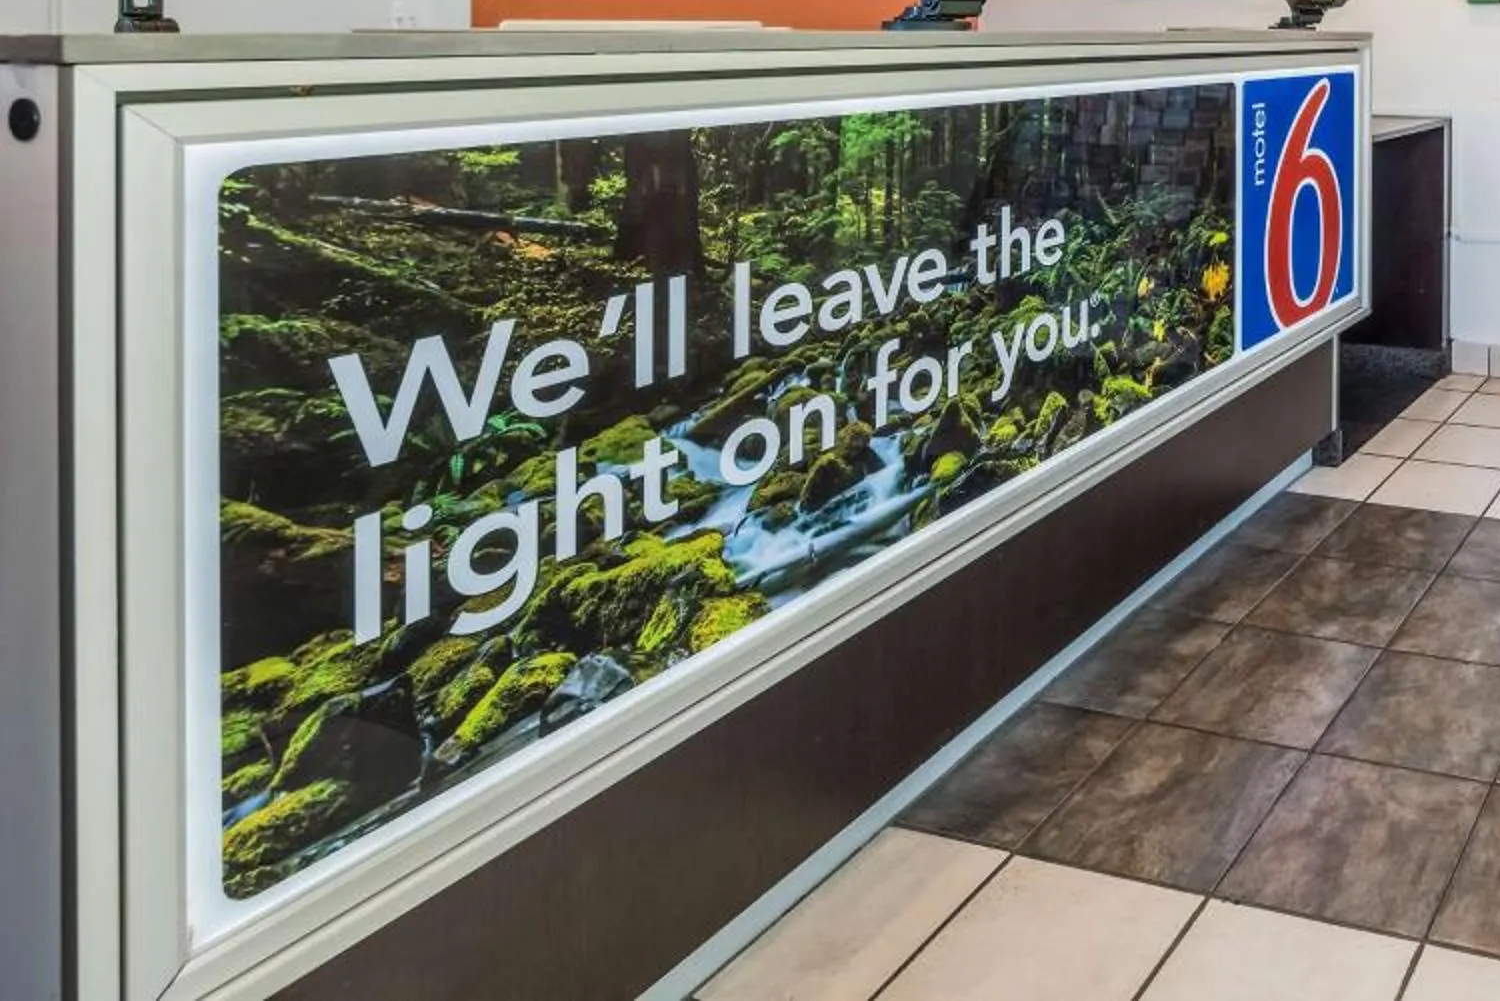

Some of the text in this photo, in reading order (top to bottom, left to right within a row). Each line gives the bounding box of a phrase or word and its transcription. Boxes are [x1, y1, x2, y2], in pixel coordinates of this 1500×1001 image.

[1251, 101, 1266, 187] motel
[1263, 76, 1344, 331] 6
[327, 206, 1066, 469] We'll leave the
[352, 435, 680, 646] light
[718, 394, 836, 487] on
[867, 338, 976, 427] for
